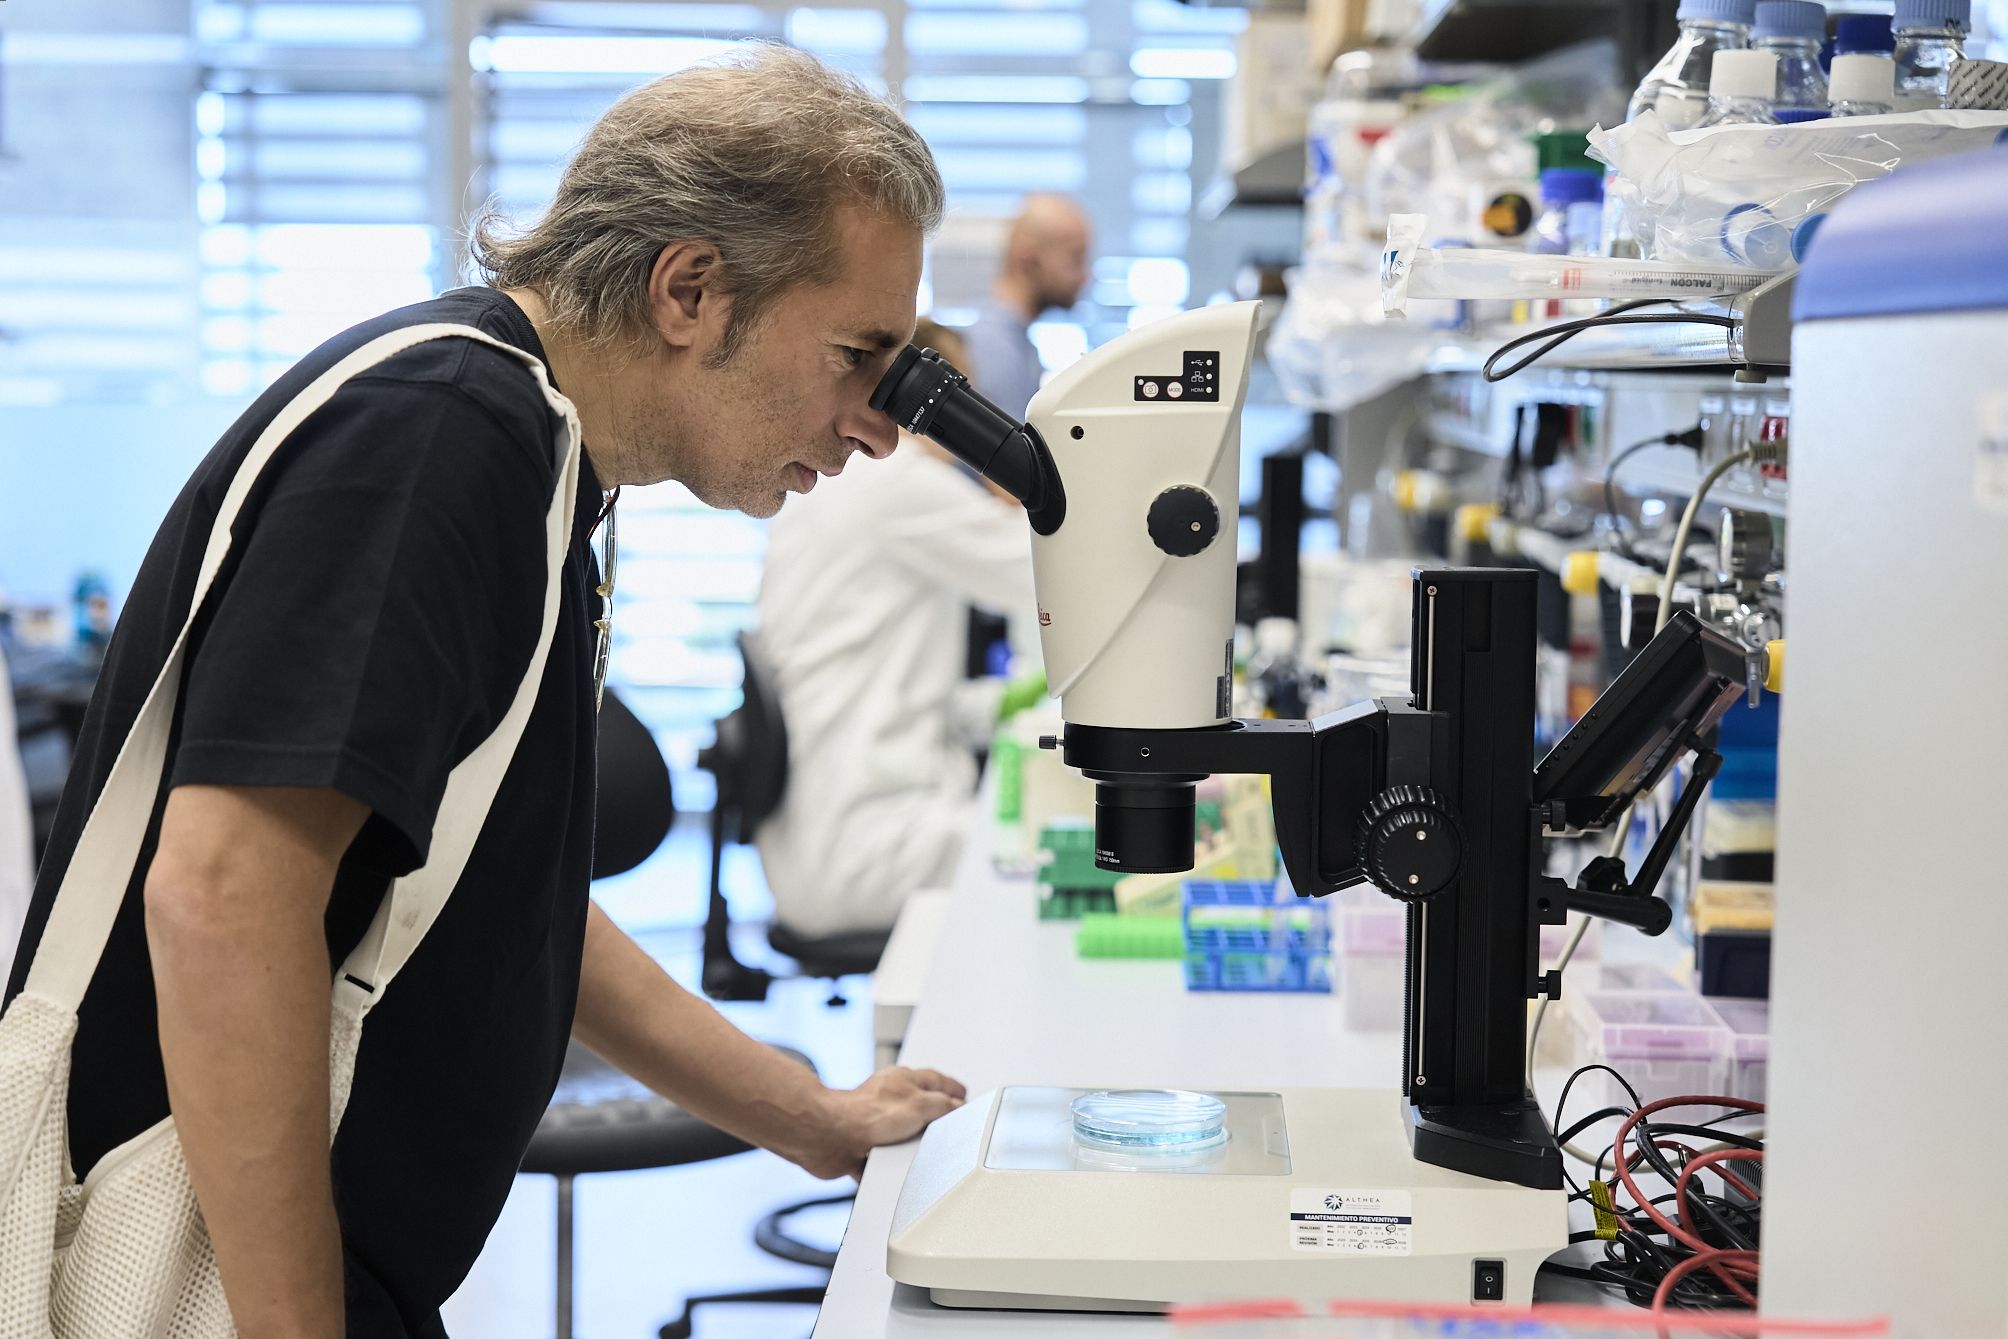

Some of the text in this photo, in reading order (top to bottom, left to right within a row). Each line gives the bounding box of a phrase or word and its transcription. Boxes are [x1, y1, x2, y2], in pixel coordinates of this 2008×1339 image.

[1670, 278, 1712, 288] FALCON
[1304, 1214, 1399, 1224] MANTENIMIENTO PREVENTIVO
